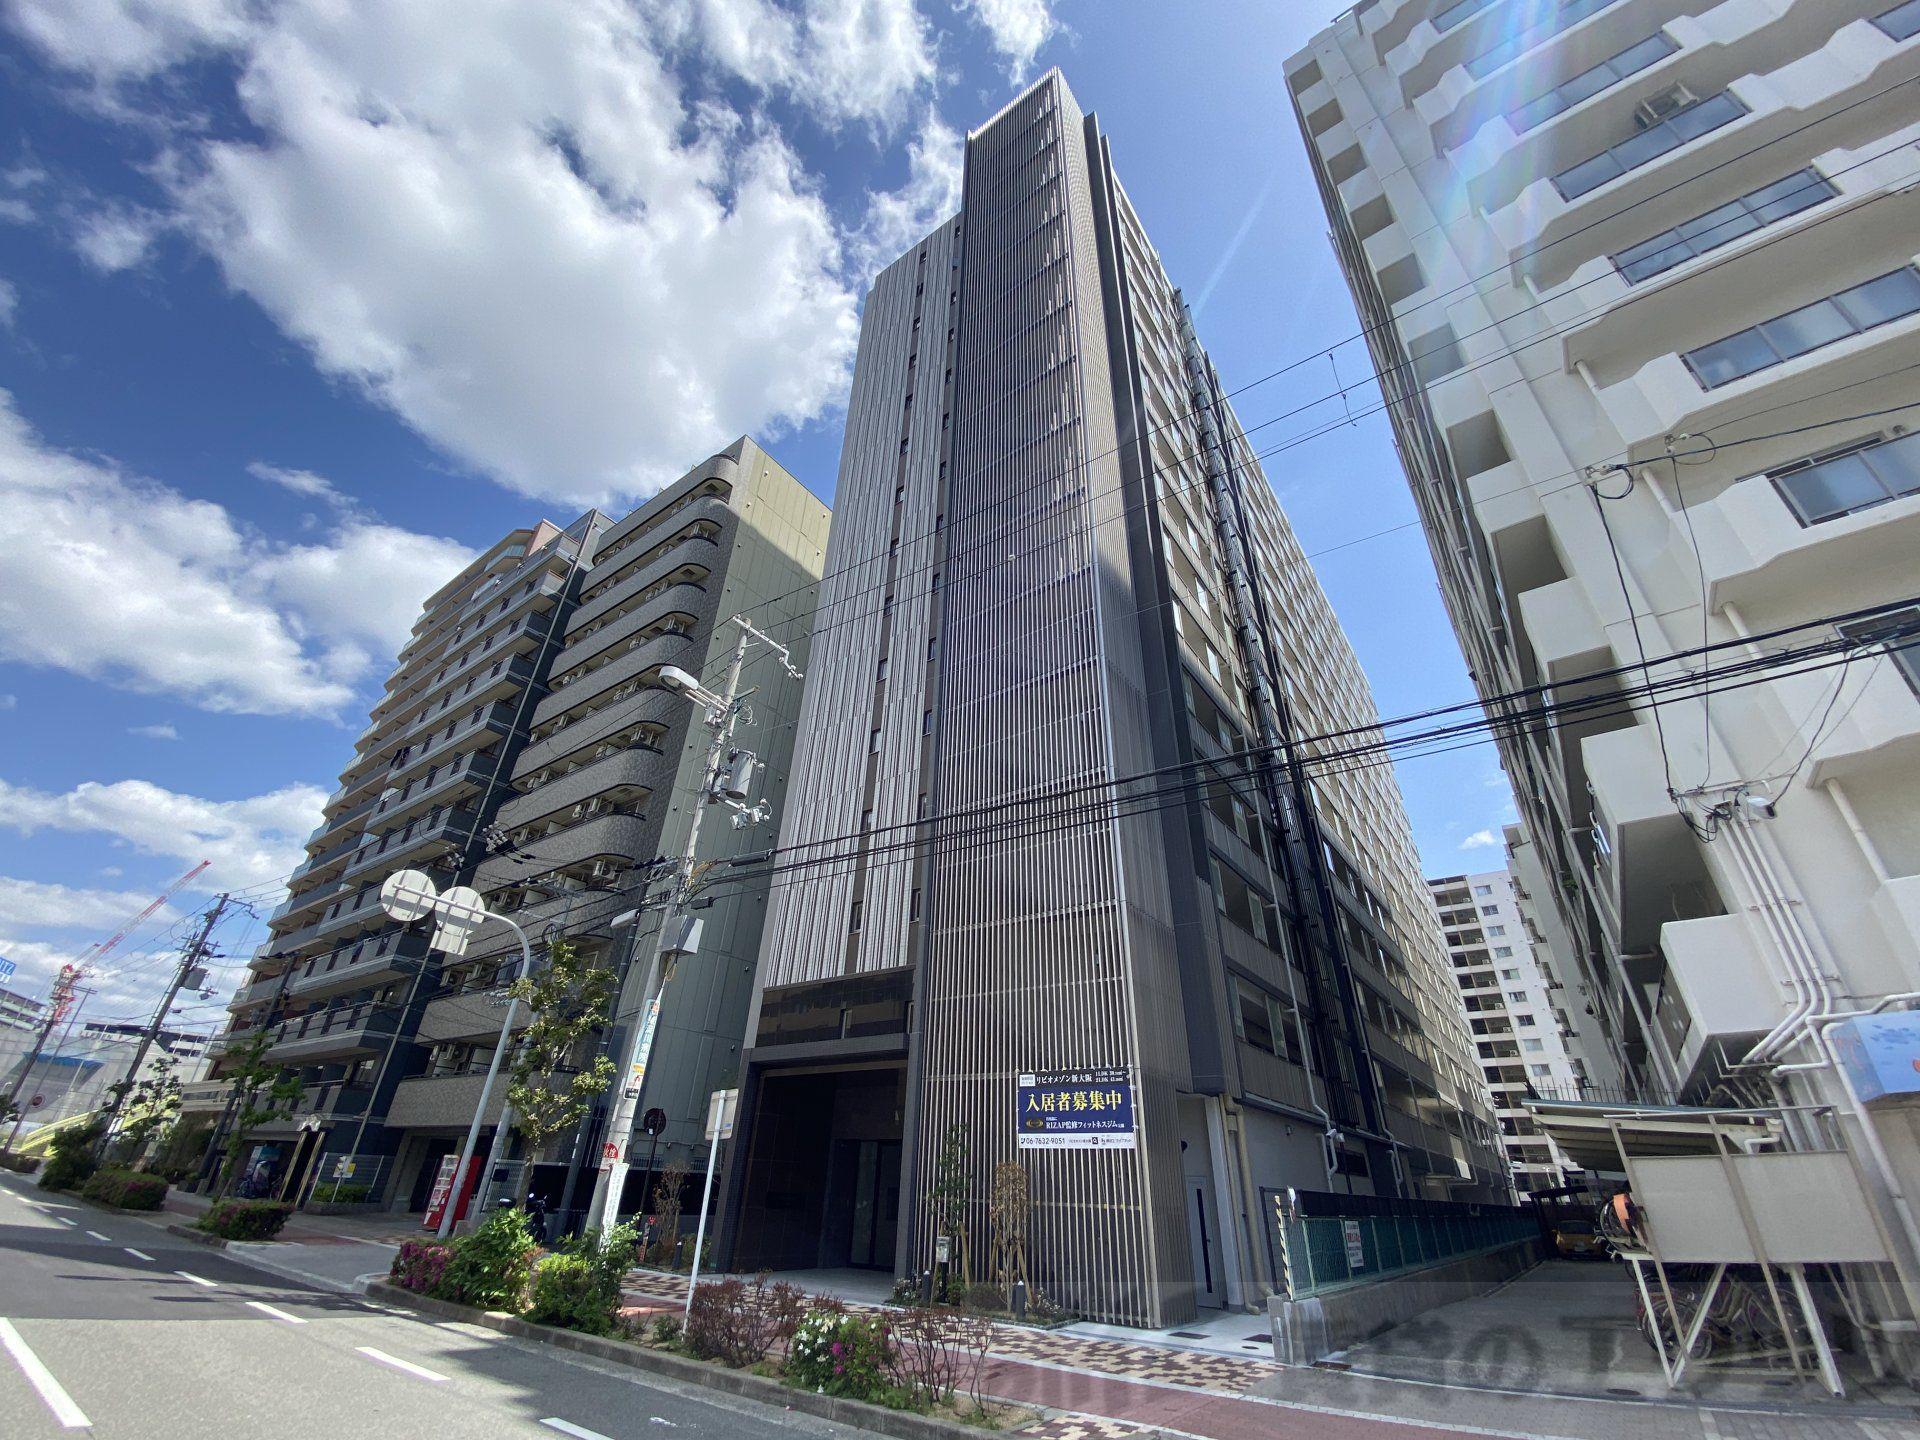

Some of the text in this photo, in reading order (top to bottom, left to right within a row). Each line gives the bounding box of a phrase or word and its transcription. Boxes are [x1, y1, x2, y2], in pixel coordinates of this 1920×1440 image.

[1036, 1074, 1092, 1084] リビオメゾン新大阪
[1026, 1090, 1122, 1113] 入居者募集中
